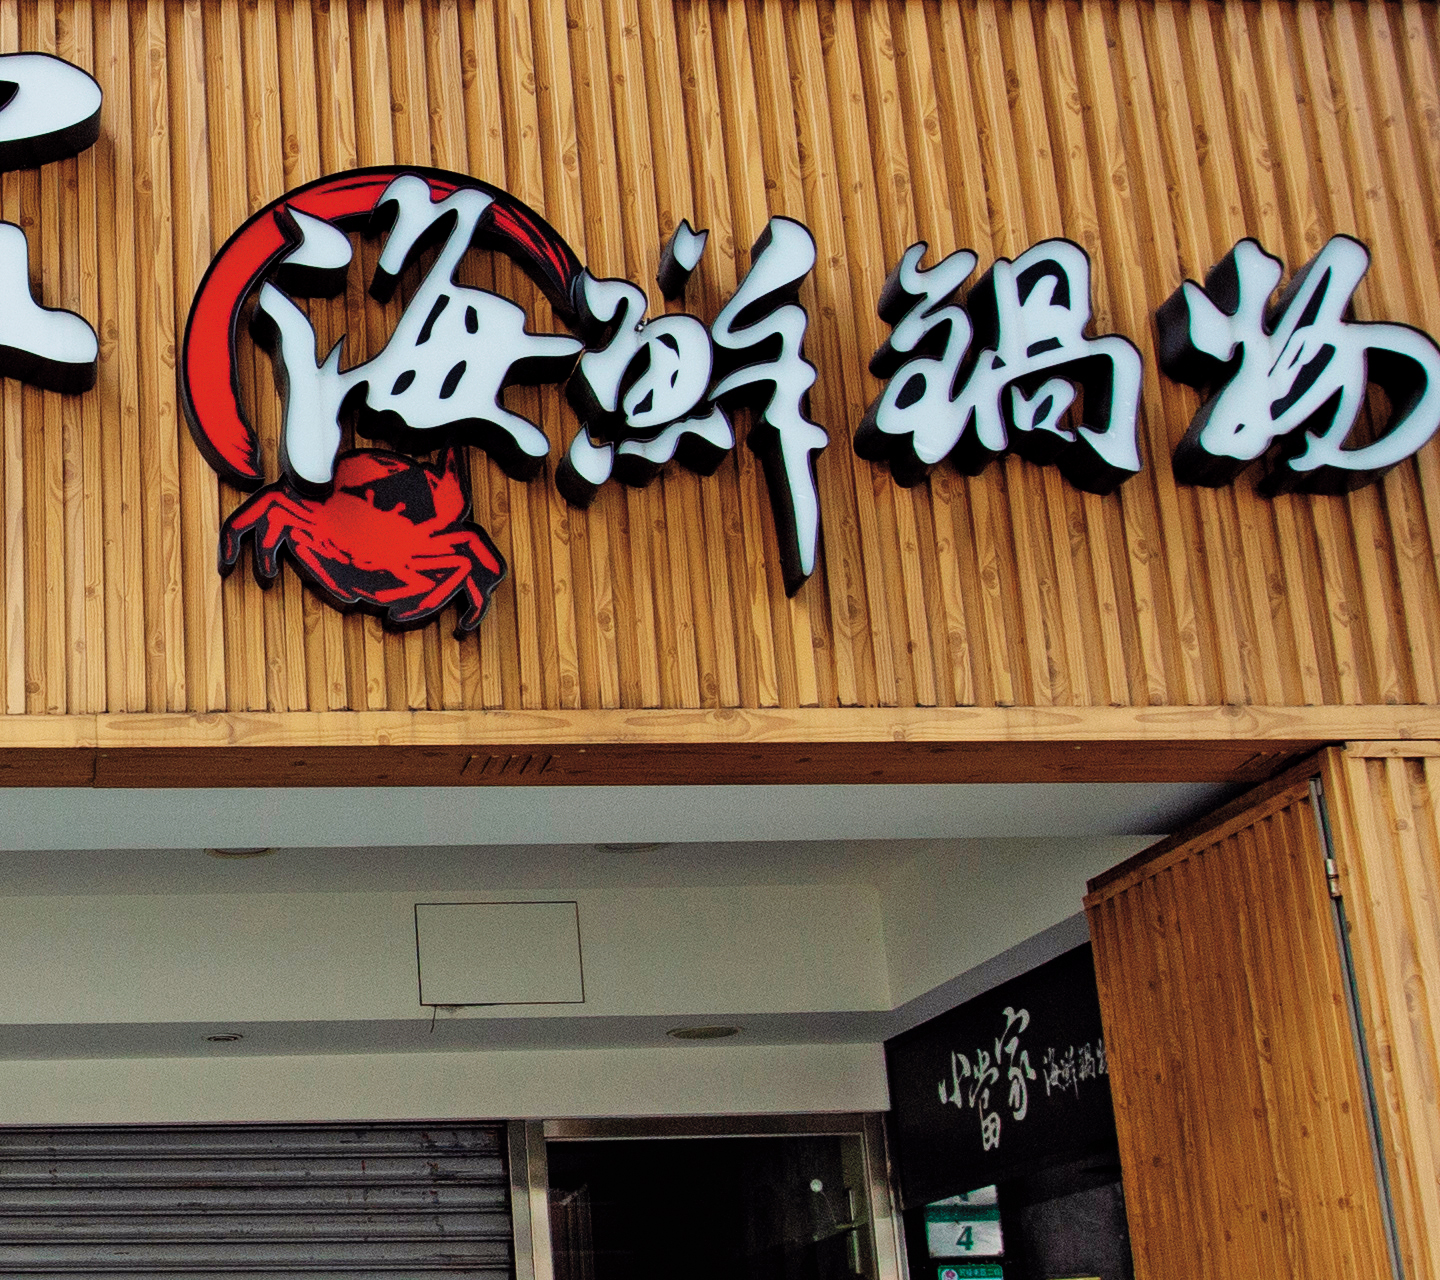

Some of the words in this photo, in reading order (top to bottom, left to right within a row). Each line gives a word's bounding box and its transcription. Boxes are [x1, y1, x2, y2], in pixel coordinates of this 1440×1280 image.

[938, 1006, 1037, 1151] 小當家
[956, 1225, 974, 1251] 4
